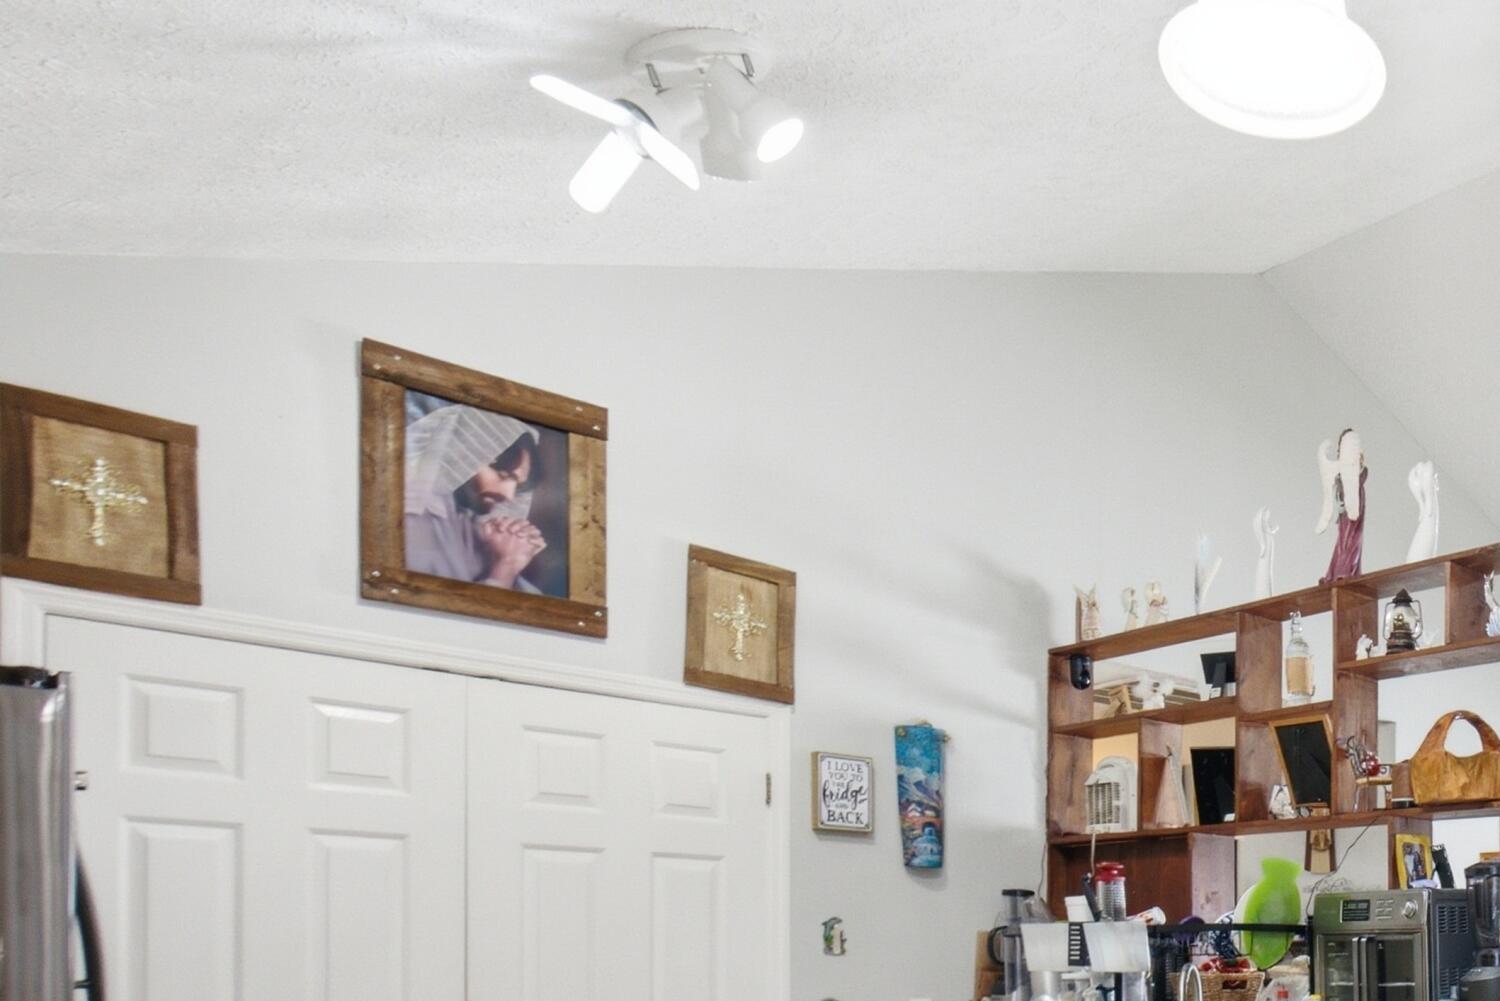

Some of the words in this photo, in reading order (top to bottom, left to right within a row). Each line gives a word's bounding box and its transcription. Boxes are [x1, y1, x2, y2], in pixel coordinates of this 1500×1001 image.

[827, 760, 831, 770] I
[835, 761, 864, 773] LOVE
[828, 771, 848, 781] YOU
[823, 779, 867, 811] fridge
[827, 809, 864, 824] BACK
